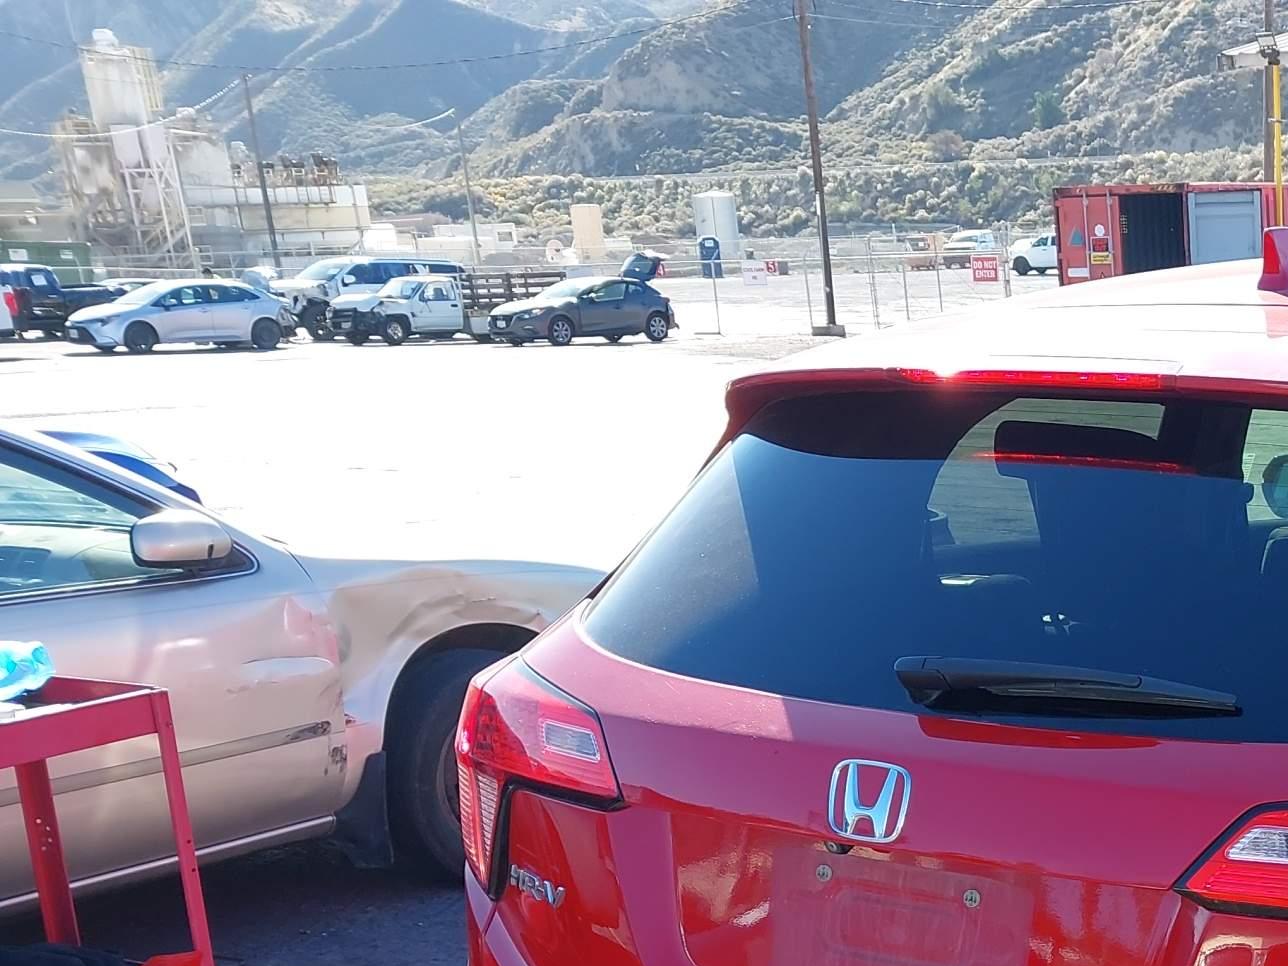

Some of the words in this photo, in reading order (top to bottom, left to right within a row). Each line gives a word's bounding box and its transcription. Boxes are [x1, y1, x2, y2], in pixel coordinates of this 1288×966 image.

[768, 261, 776, 273] 5
[973, 260, 983, 269] DO
[983, 260, 996, 269] NOT
[975, 269, 996, 278] ENTER
[510, 864, 566, 909] HR-V
